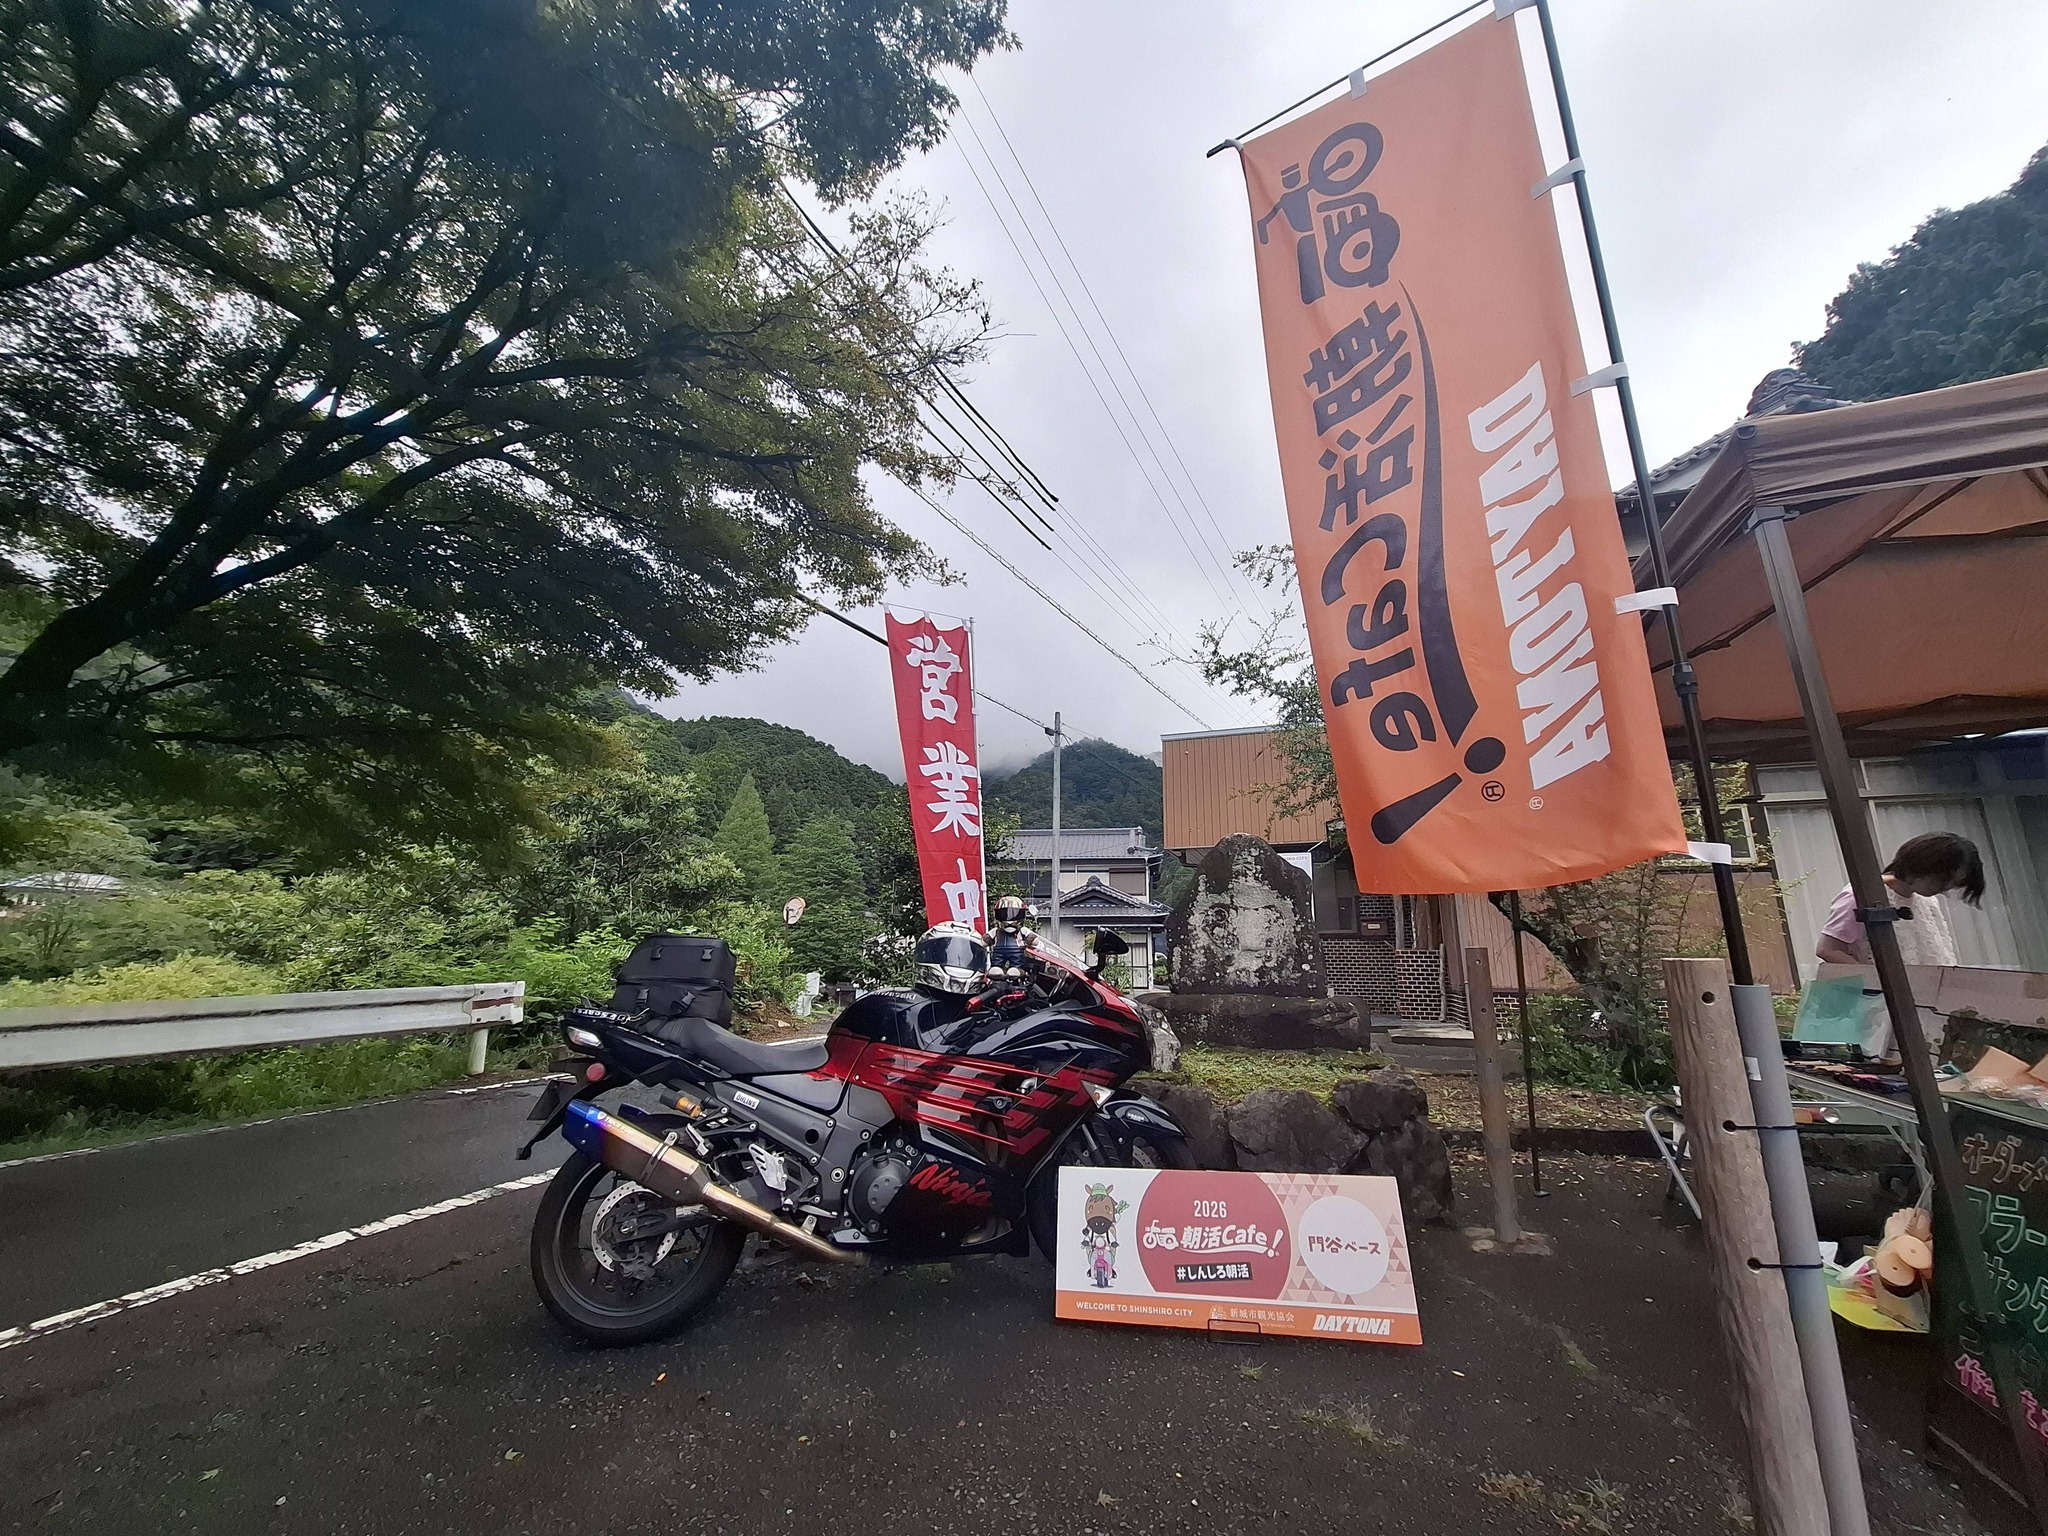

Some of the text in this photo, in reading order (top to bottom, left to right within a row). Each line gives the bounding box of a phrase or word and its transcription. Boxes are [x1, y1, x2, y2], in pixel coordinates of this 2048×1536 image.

[906, 632, 981, 929] 営業中
[910, 1164, 992, 1206] Ninja
[1193, 1200, 1227, 1218] 2026
[1307, 1235, 1382, 1256] 門谷ベース
[1177, 1263, 1250, 1281] #しんしろ朝活
[1076, 1301, 1194, 1317] WELCOME TO SHINSHIRO CITY
[1230, 1308, 1295, 1322] 新城市観光協会
[1313, 1314, 1391, 1336] DAYTONA
